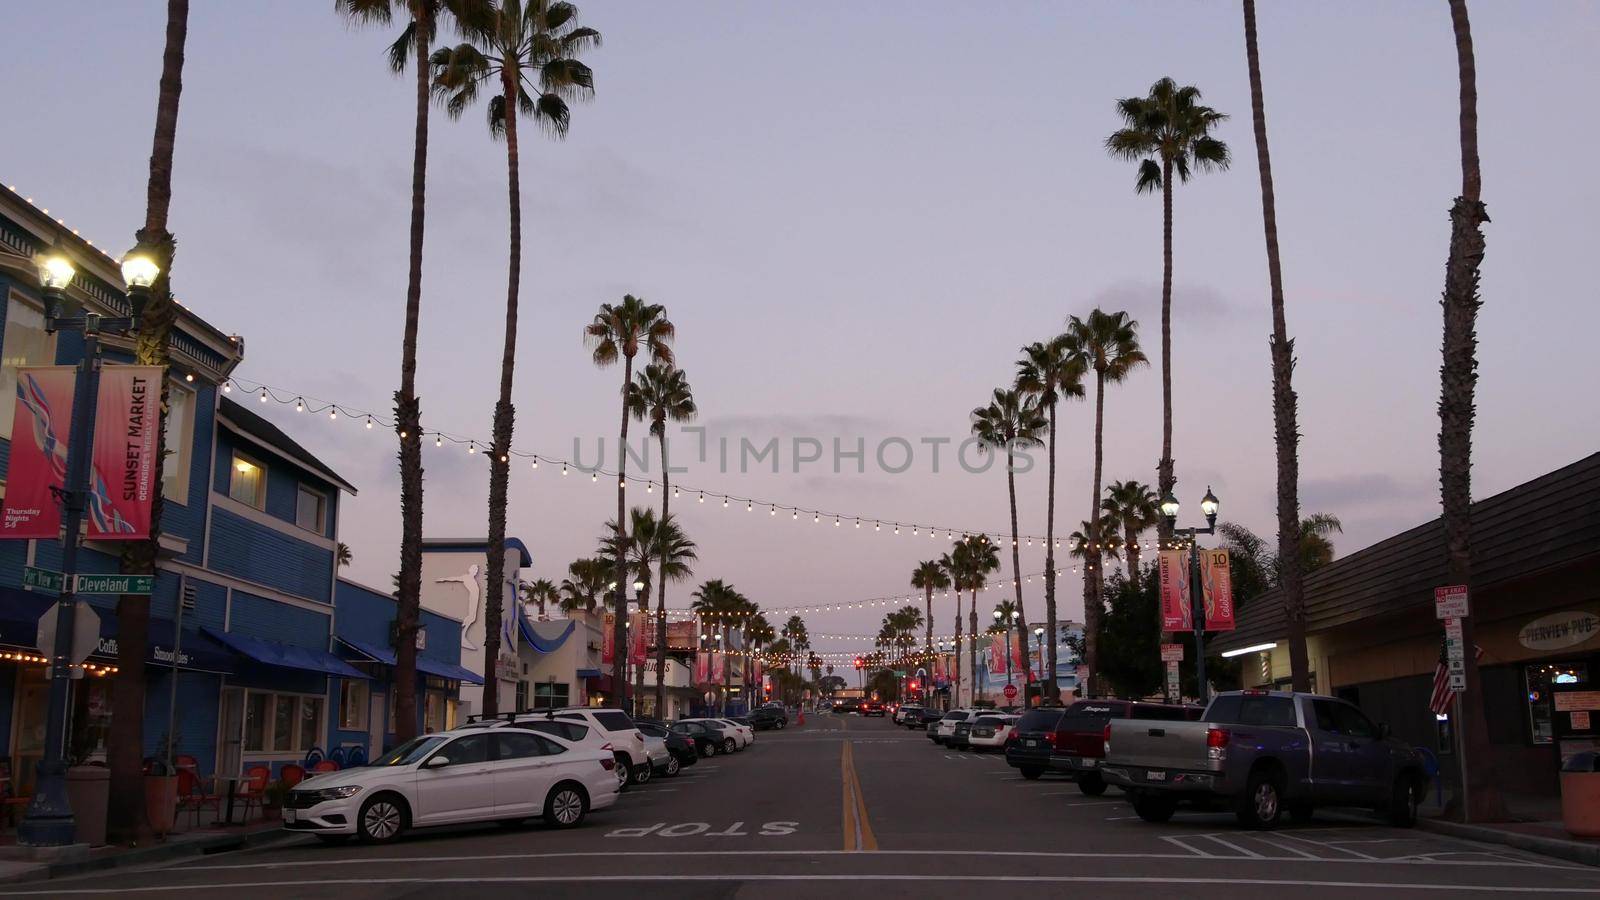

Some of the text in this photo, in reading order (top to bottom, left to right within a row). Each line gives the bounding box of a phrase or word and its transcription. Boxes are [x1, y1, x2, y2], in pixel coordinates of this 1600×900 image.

[123, 376, 147, 501] SUNSET MARKET
[6, 508, 41, 516] Thursday
[1212, 553, 1227, 565] 10
[78, 576, 129, 592] Cleveland
[1525, 616, 1592, 642] PIERVIEW PUB
[1005, 687, 1017, 695] STOP
[604, 821, 800, 837] STOP
